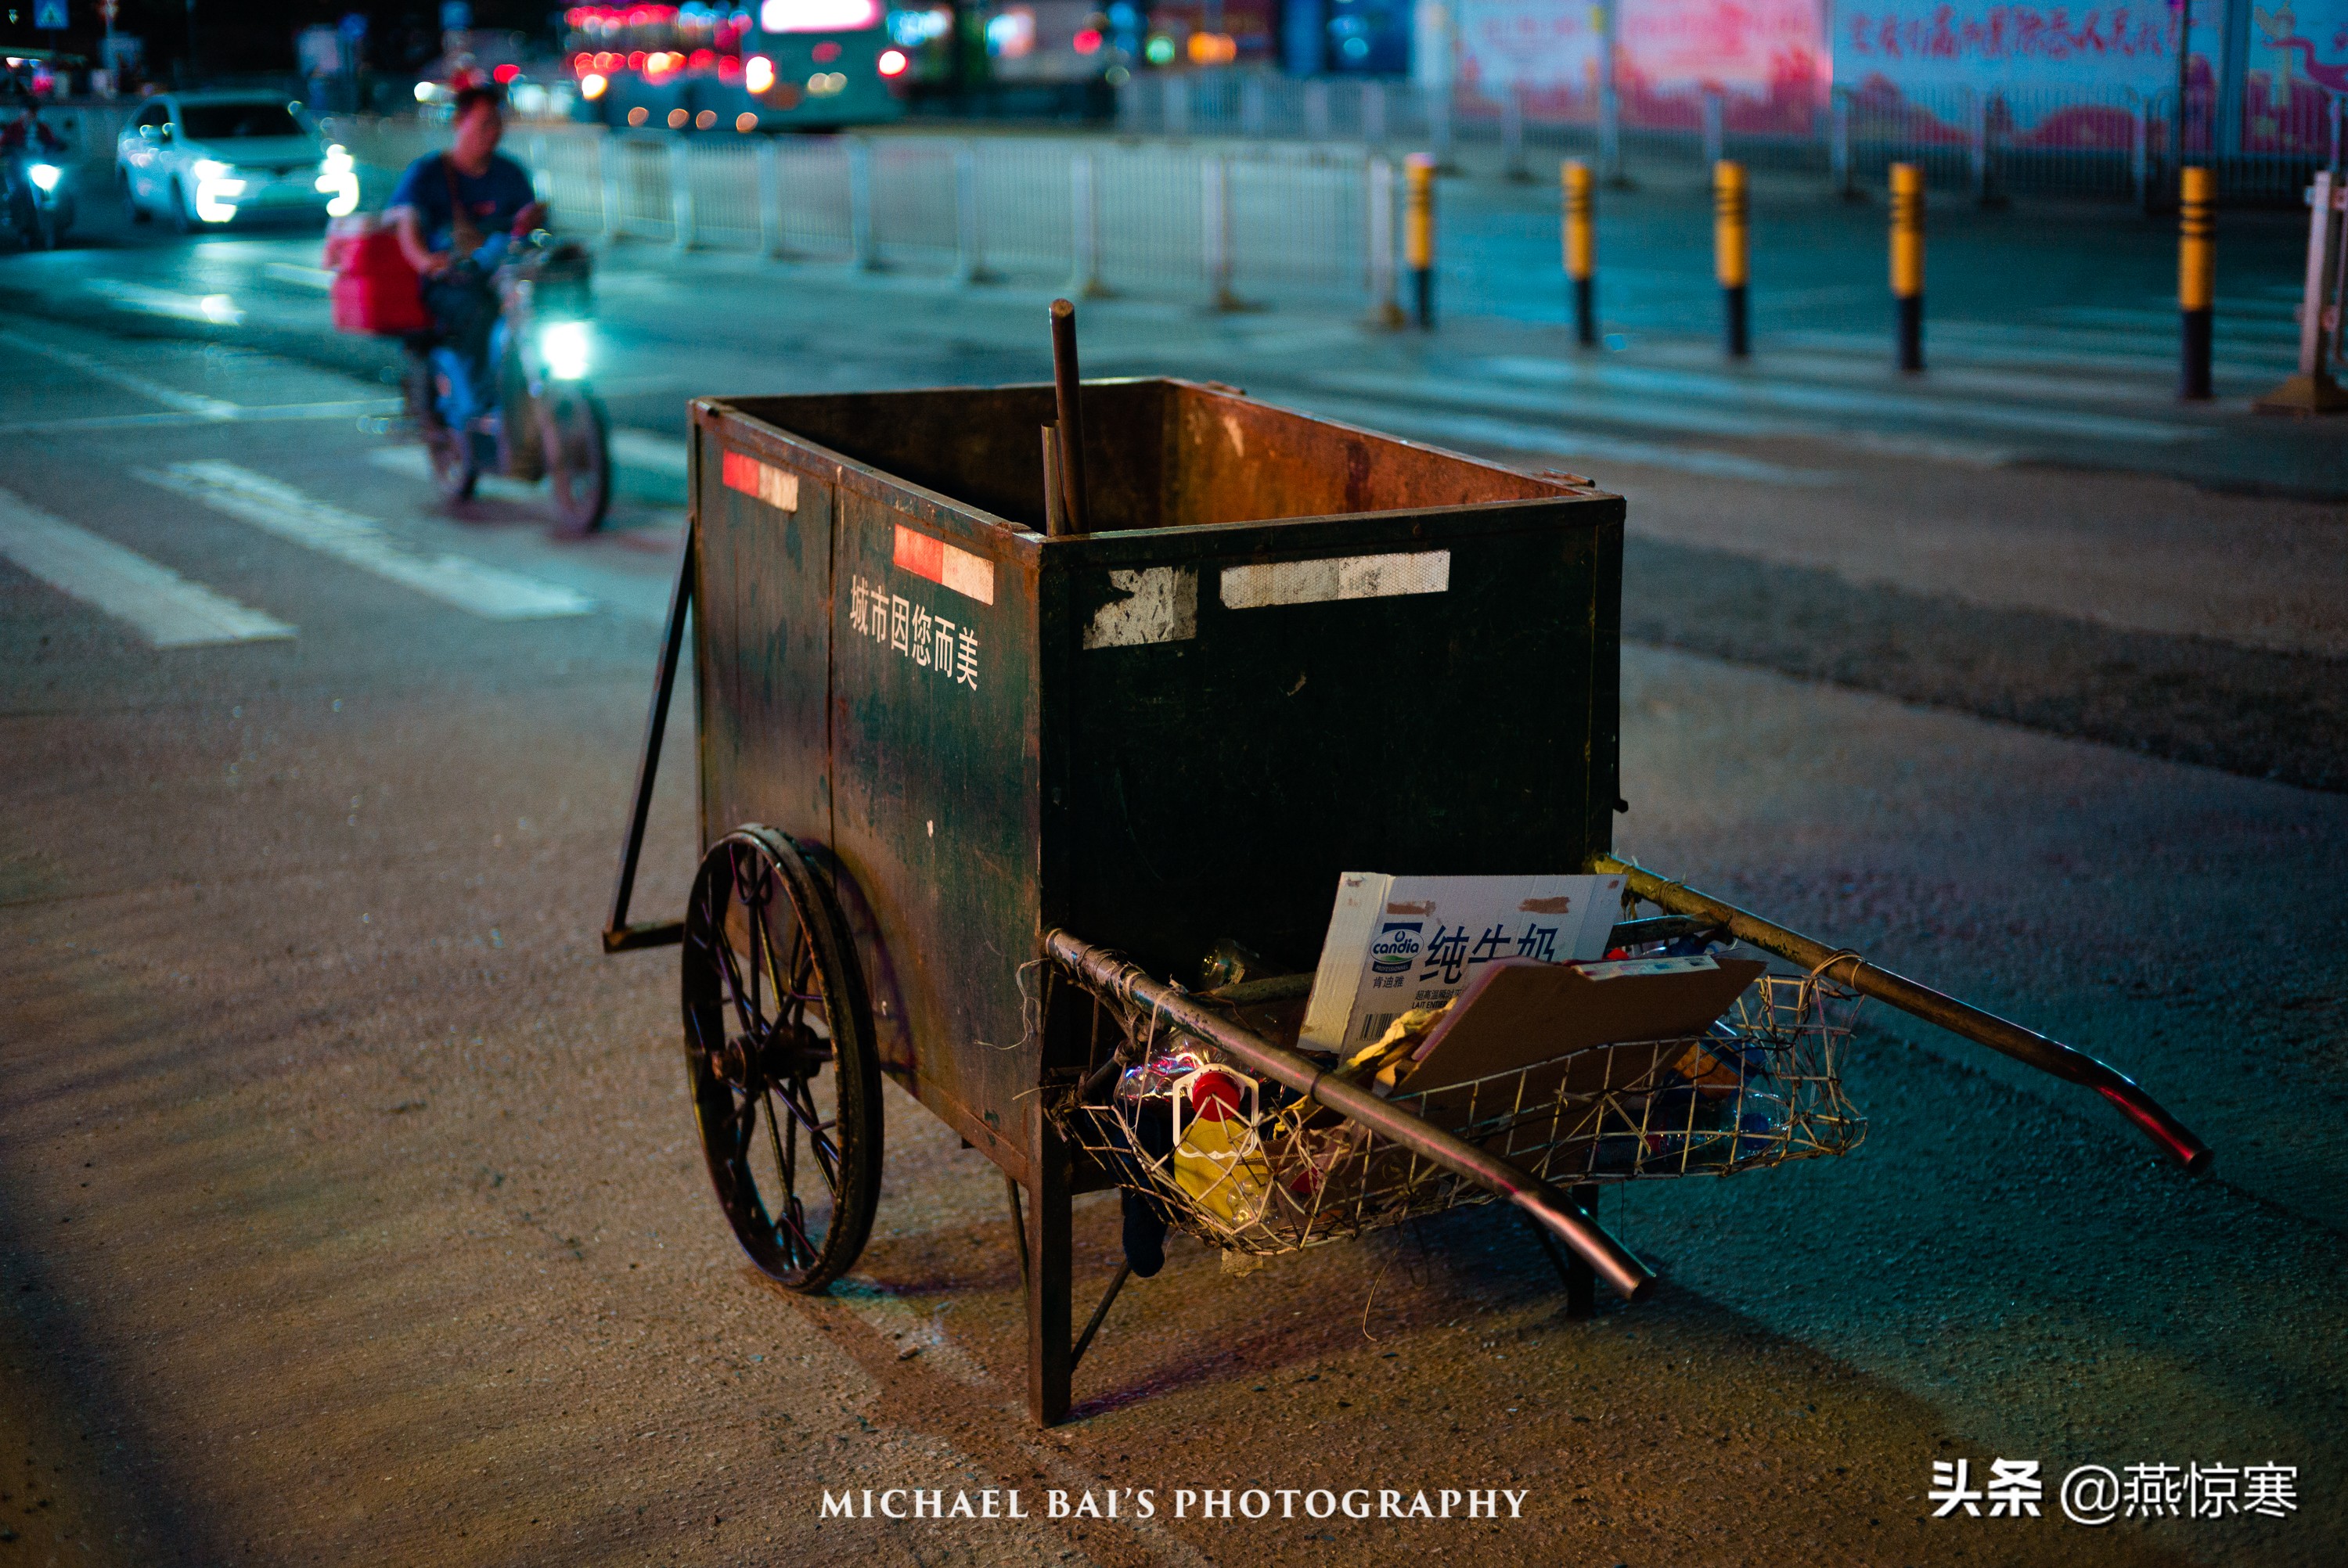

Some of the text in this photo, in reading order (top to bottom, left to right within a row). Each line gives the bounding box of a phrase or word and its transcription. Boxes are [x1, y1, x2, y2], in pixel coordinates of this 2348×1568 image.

[850, 574, 978, 691] 城市因您而美
[1373, 938, 1420, 955] candia
[1419, 922, 1559, 984] 纯牛奶
[1373, 976, 1404, 989] 肯迪雅
[1411, 1001, 1426, 1009] LAIT
